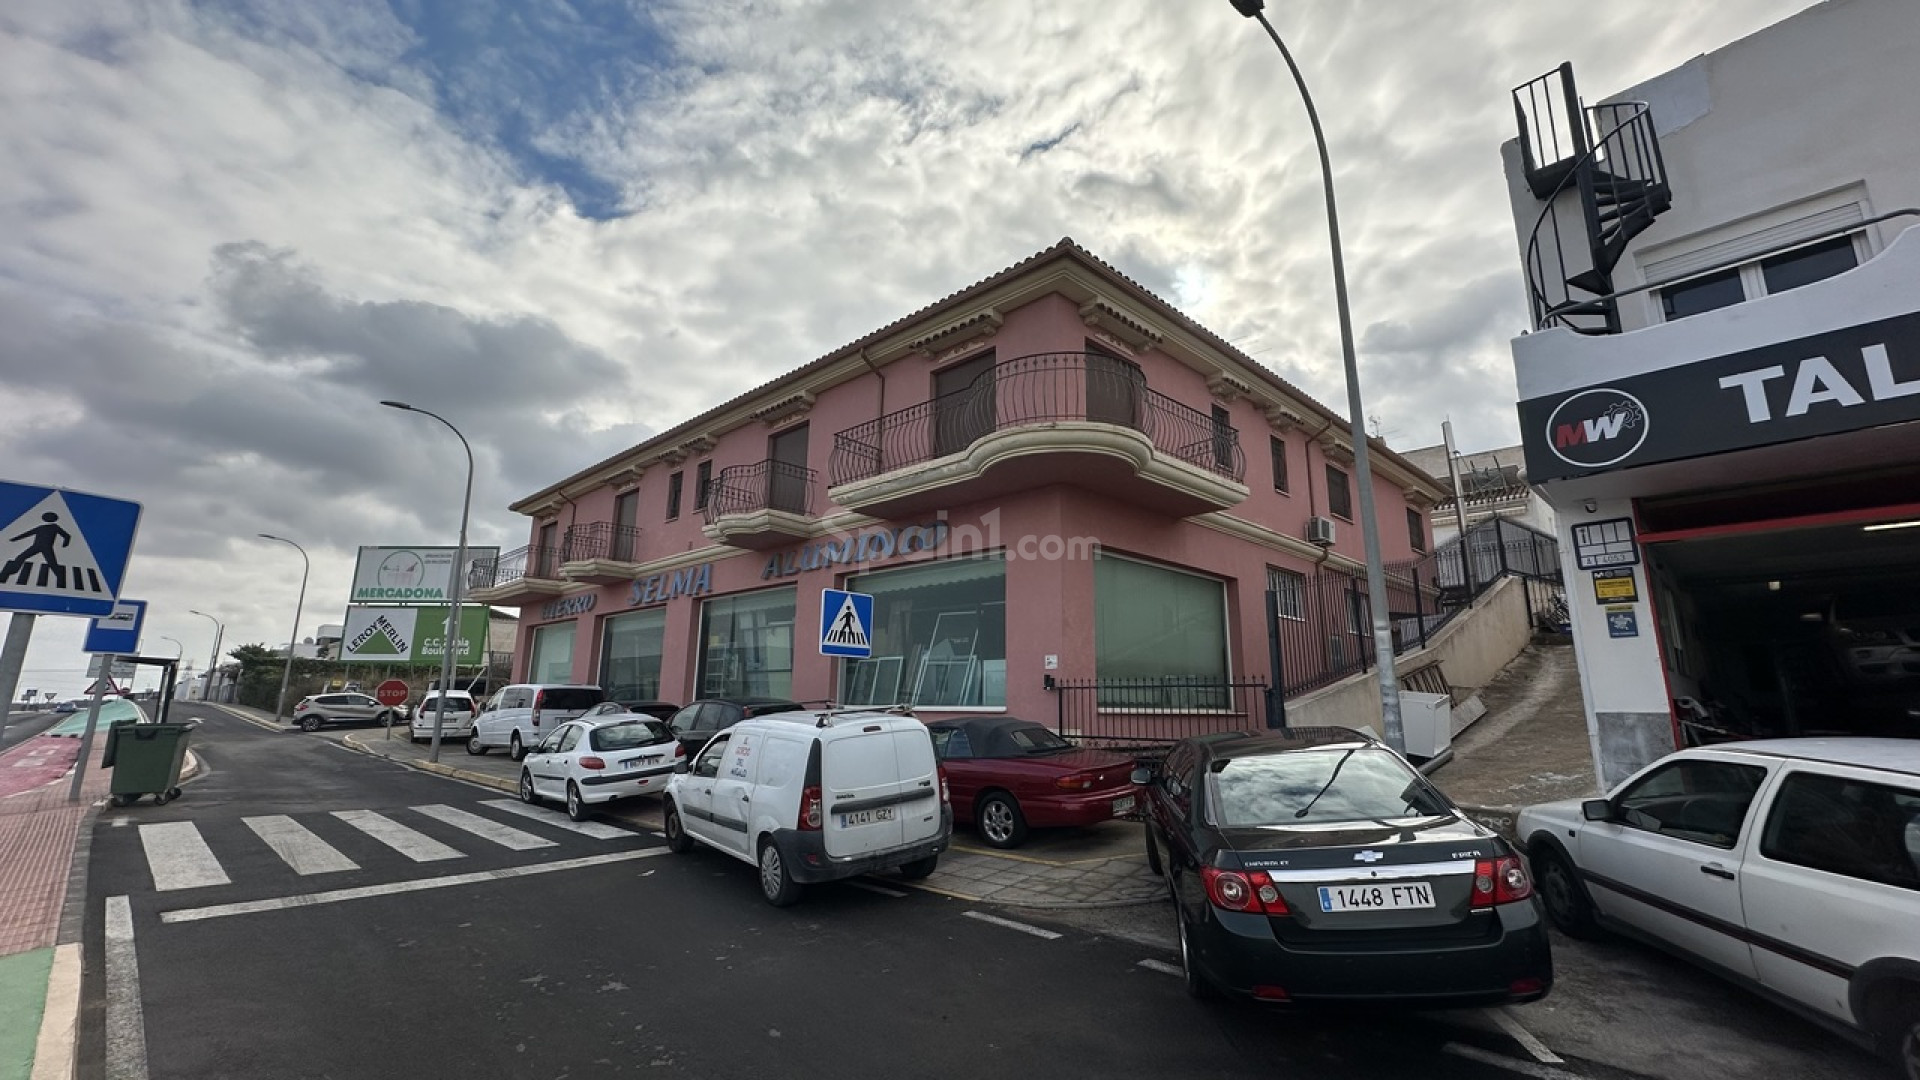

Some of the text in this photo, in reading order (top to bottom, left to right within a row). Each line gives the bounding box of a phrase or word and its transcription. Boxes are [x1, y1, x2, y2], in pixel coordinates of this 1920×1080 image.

[1718, 343, 1920, 424] TAL
[1556, 412, 1627, 448] MW
[357, 587, 444, 598] MERCADONA
[629, 563, 713, 607] SELMA
[346, 614, 409, 653] LEROY MERLIN
[379, 689, 406, 697] STOP
[848, 810, 871, 825] 4141
[1337, 885, 1430, 908] 1448 FTN
